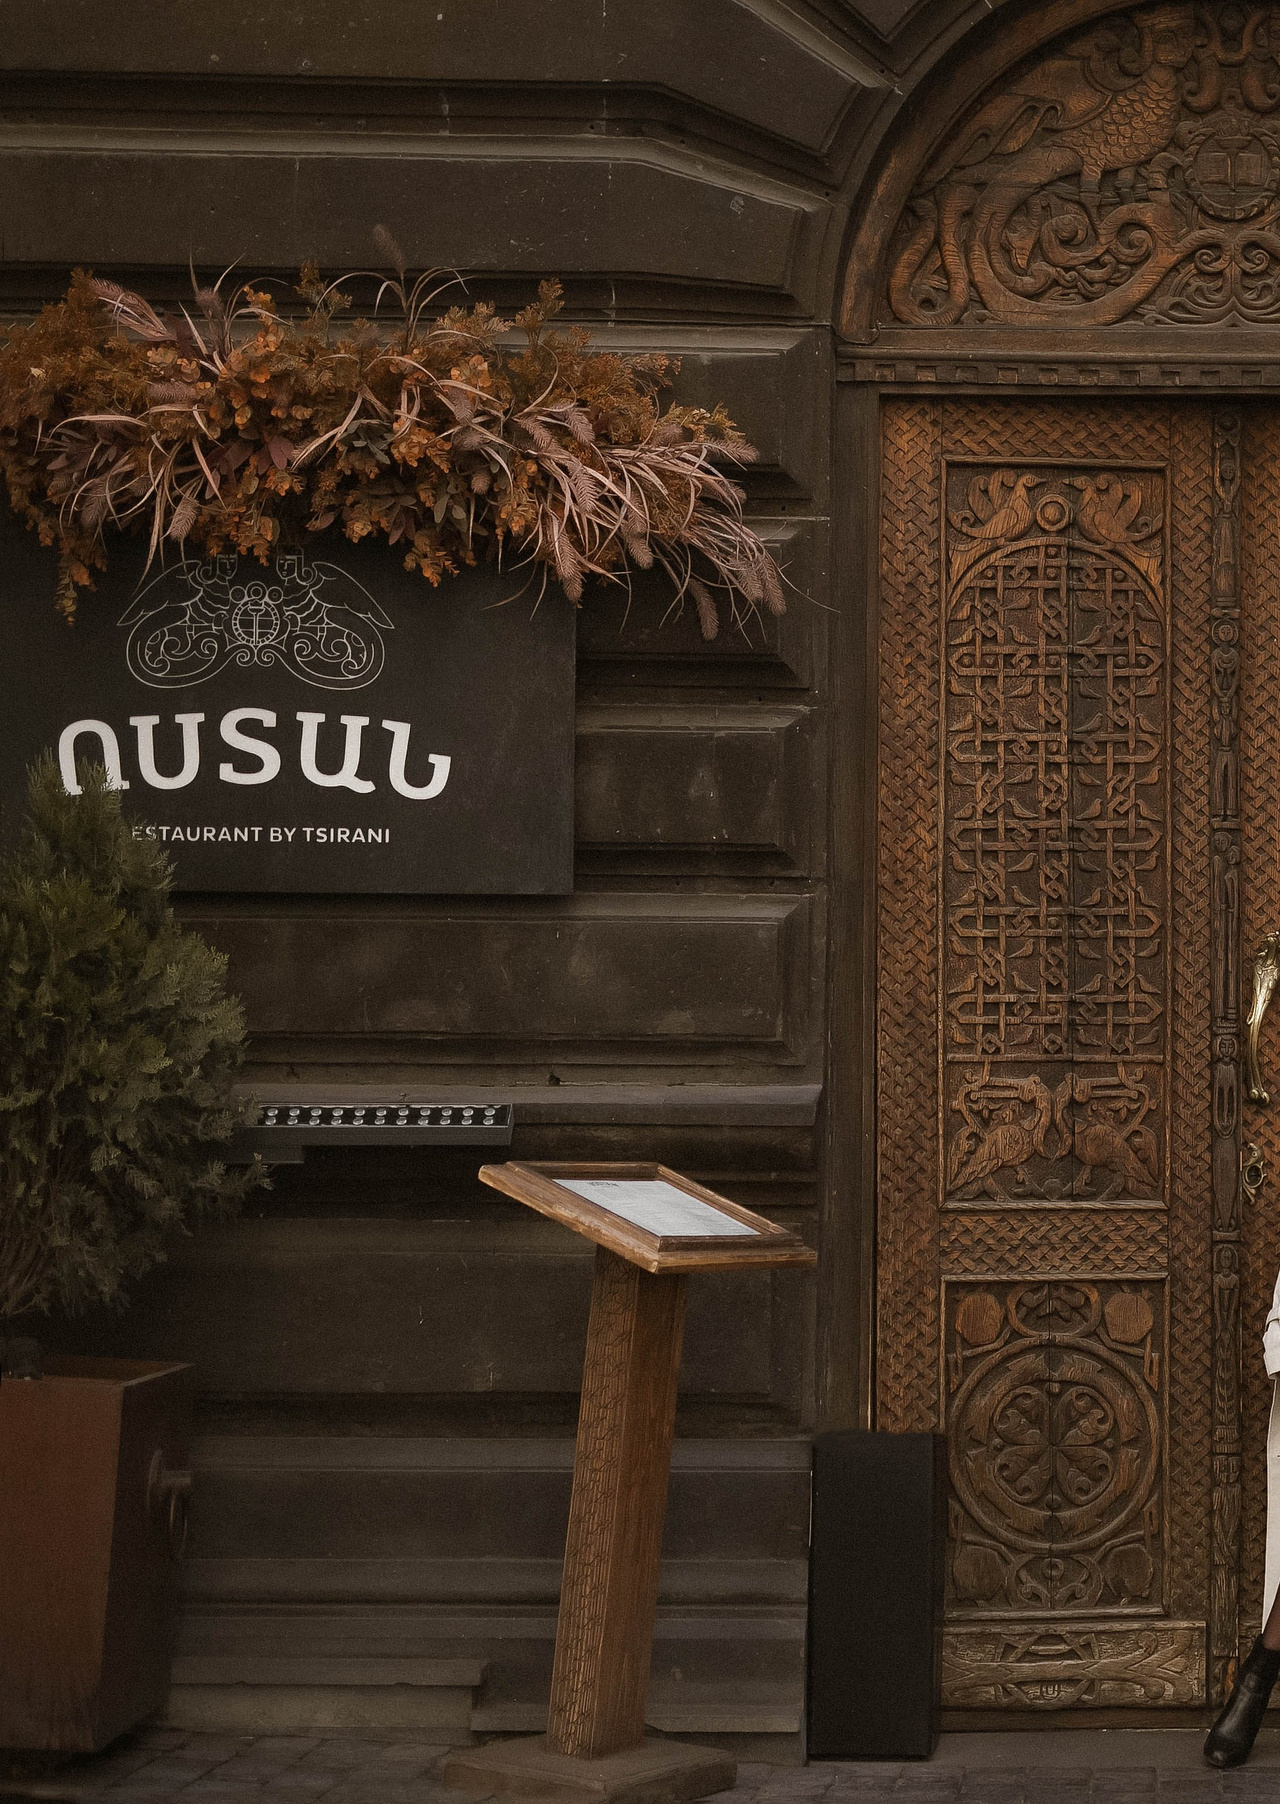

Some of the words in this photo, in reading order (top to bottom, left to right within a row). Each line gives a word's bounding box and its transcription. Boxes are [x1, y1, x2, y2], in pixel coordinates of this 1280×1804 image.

[131, 825, 263, 842] ESTAURANT
[269, 827, 297, 842] BY
[302, 827, 391, 843] TSIRANI
